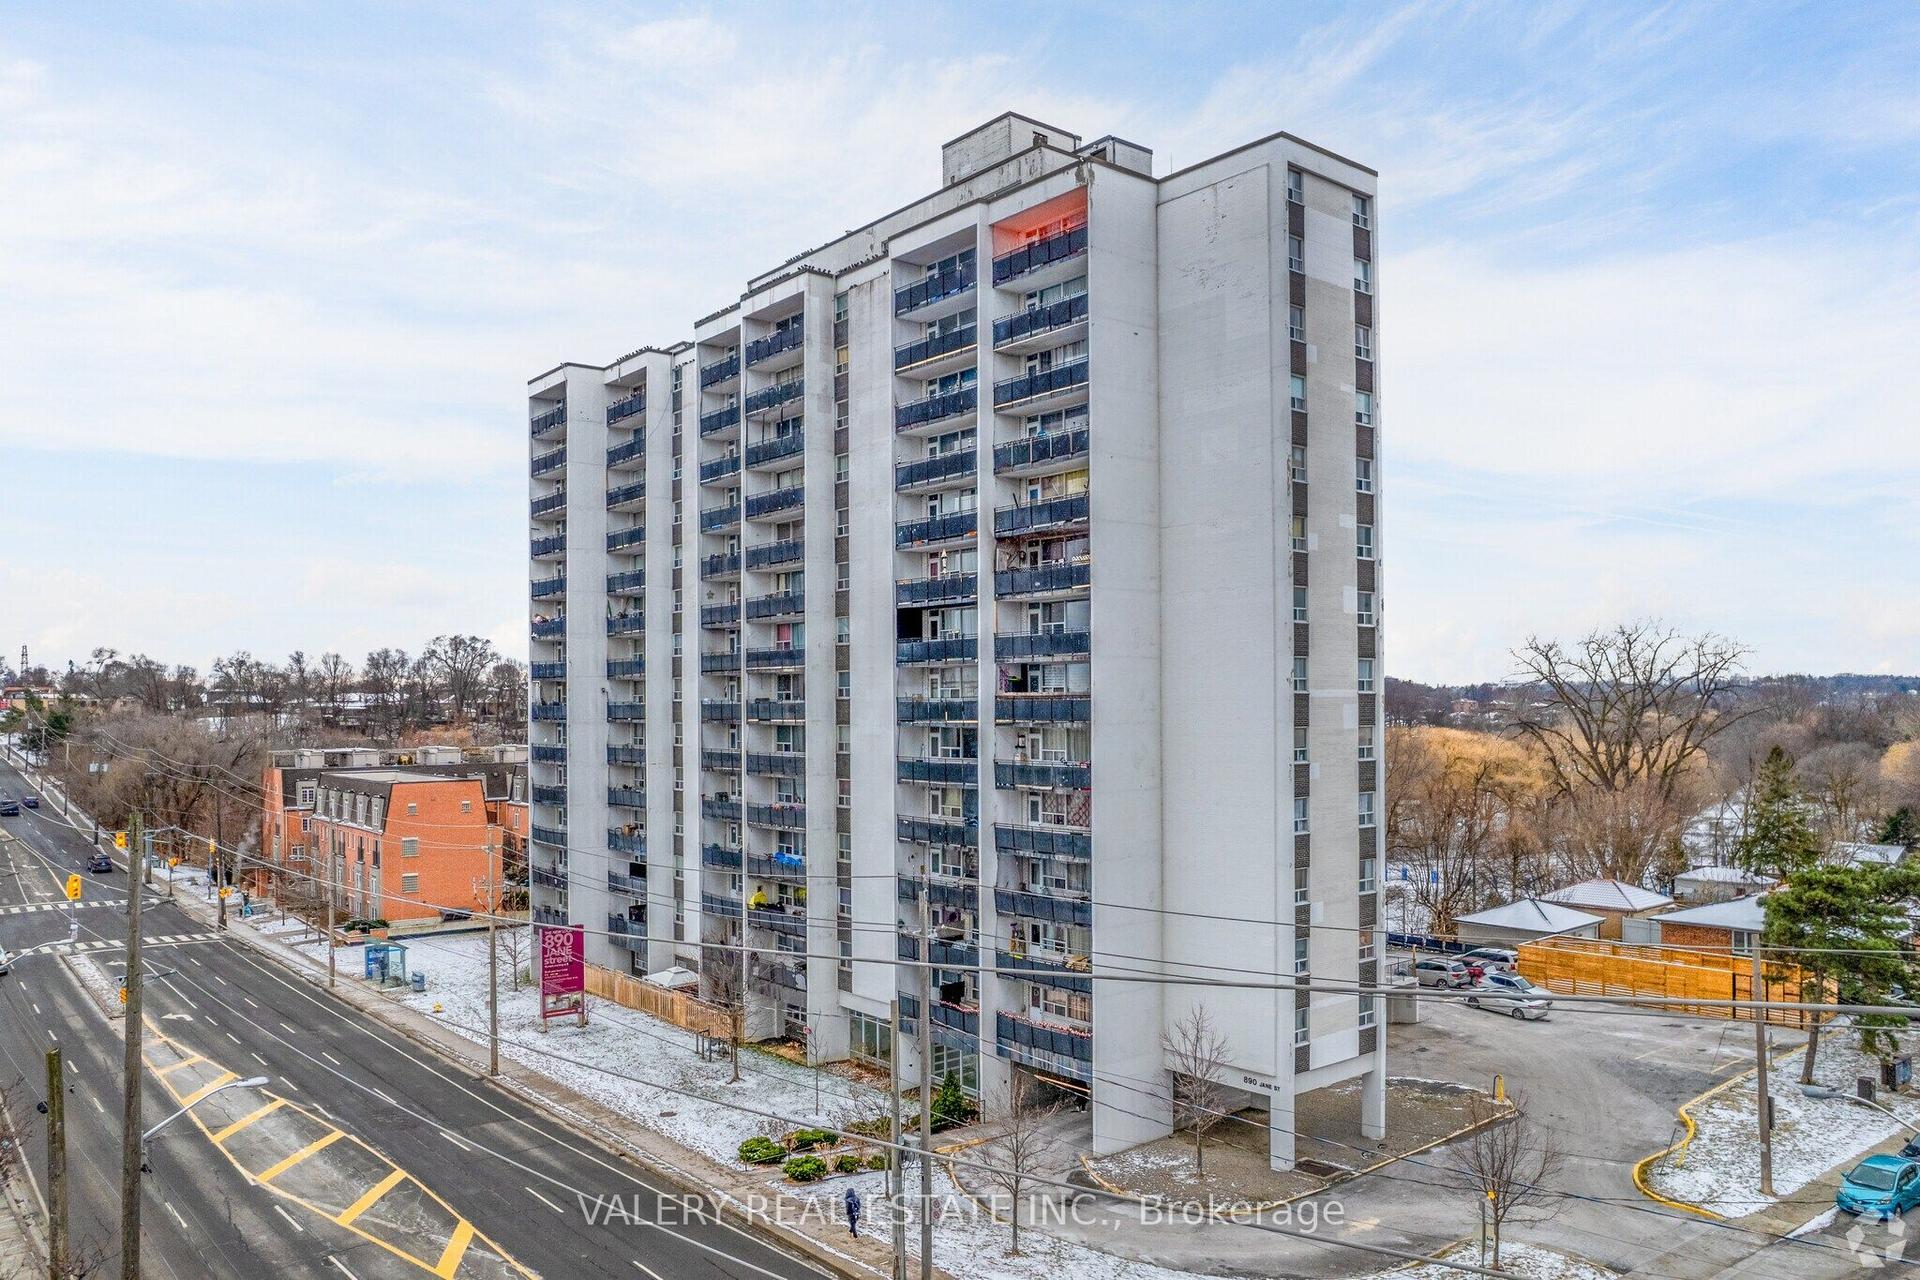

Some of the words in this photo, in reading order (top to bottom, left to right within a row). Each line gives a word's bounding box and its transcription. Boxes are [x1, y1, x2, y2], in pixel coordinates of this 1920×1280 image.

[544, 932, 574, 949] 890
[544, 945, 573, 957] JANE
[544, 954, 573, 965] street
[1243, 1076, 1257, 1086] 890
[1259, 1082, 1272, 1090] JANE
